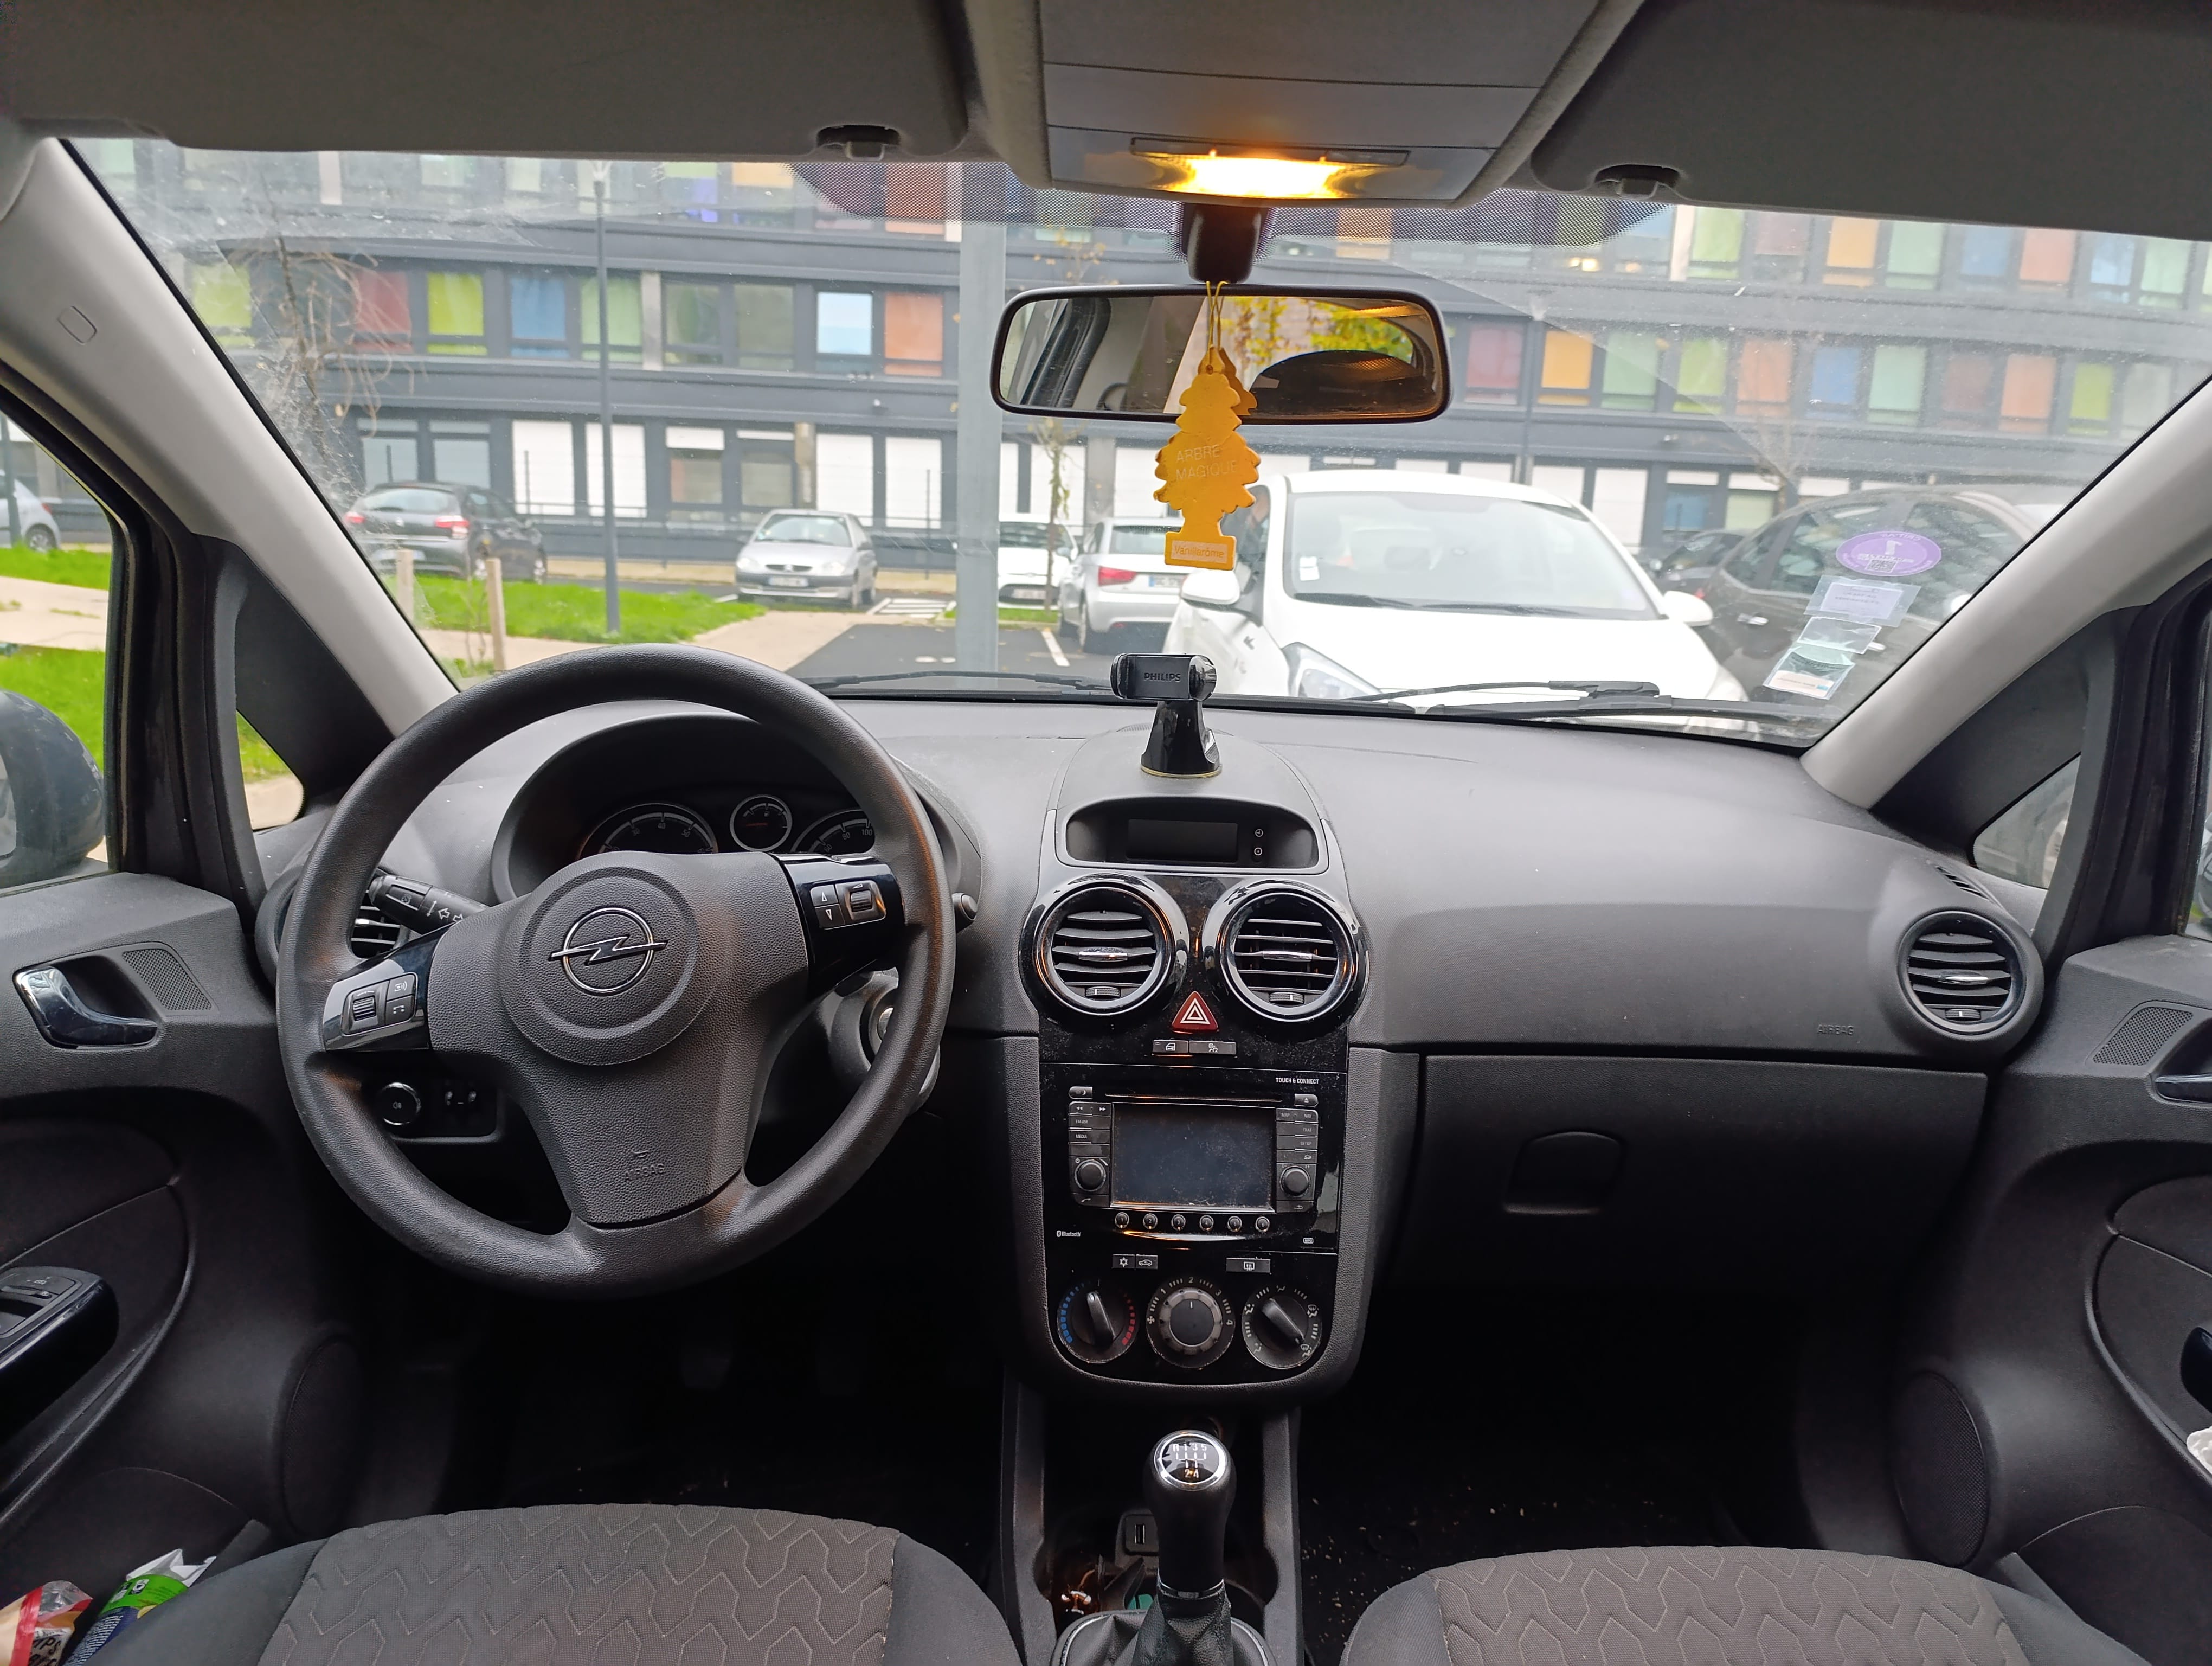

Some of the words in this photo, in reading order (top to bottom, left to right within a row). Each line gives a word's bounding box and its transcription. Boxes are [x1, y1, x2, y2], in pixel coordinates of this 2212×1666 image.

[1176, 444, 1220, 463] ARBRE
[1176, 460, 1237, 480] MAGIQUE
[1174, 544, 1225, 559] Vanillarôme
[1144, 672, 1181, 682] PHILIPS
[681, 829, 691, 838] 50
[842, 832, 851, 840] 80
[824, 844, 832, 853] 60
[1817, 1024, 1854, 1036] AIRBAG
[1173, 1444, 1179, 1452] R
[1185, 1469, 1191, 1478] 2
[1193, 1469, 1199, 1478] 4
